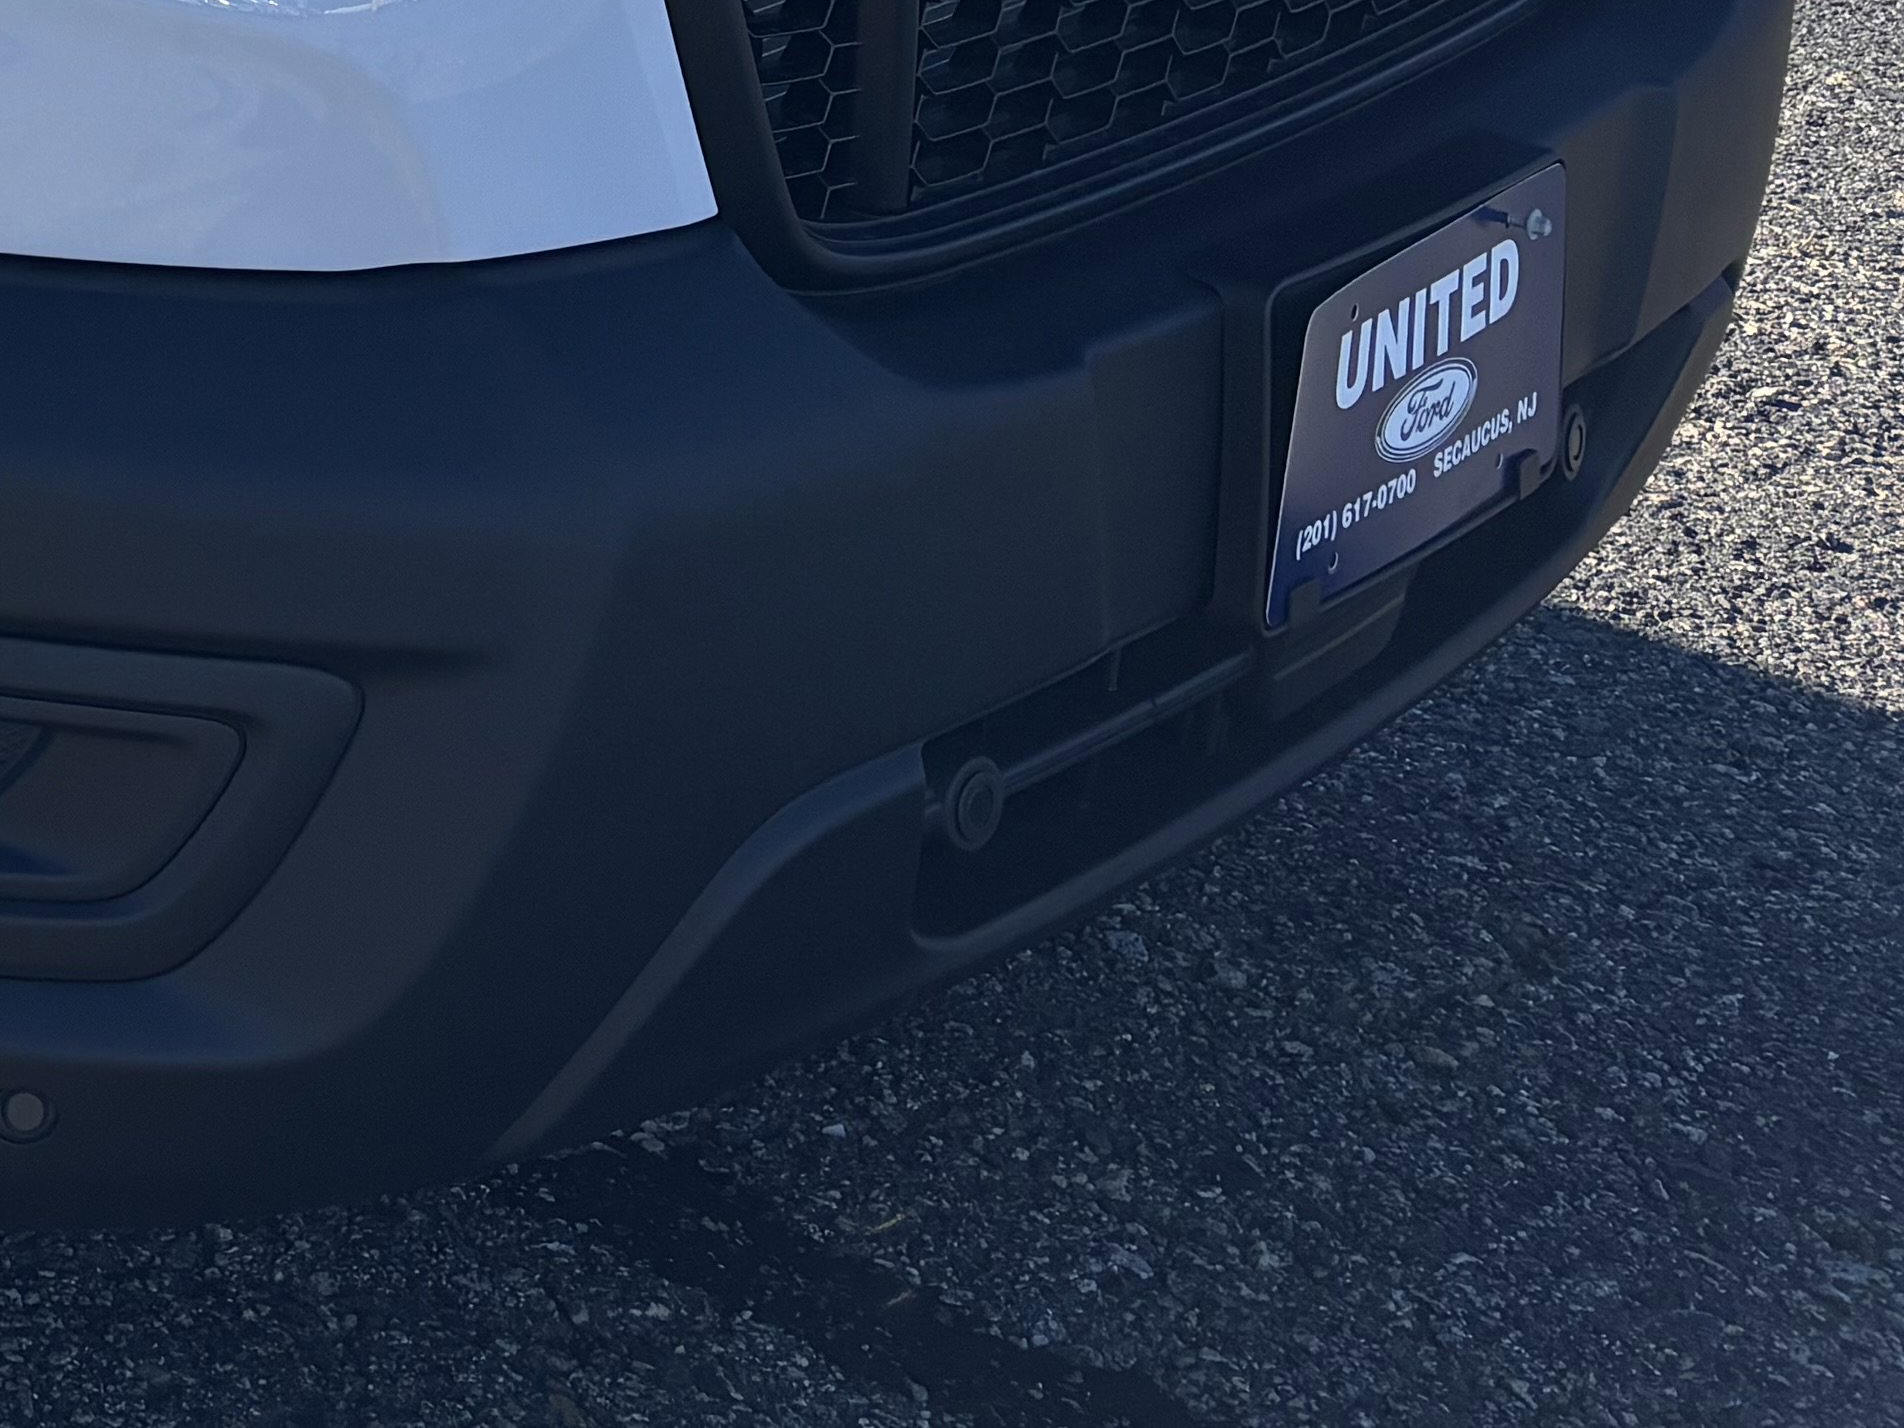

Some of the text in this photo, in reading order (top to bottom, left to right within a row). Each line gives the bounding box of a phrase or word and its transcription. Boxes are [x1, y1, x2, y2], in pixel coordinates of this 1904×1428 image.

[1335, 239, 1519, 410] UNITED
[1295, 391, 1537, 560] (201) 617-0700 SECAUCUS, NJ
[1400, 377, 1456, 442] Ford
